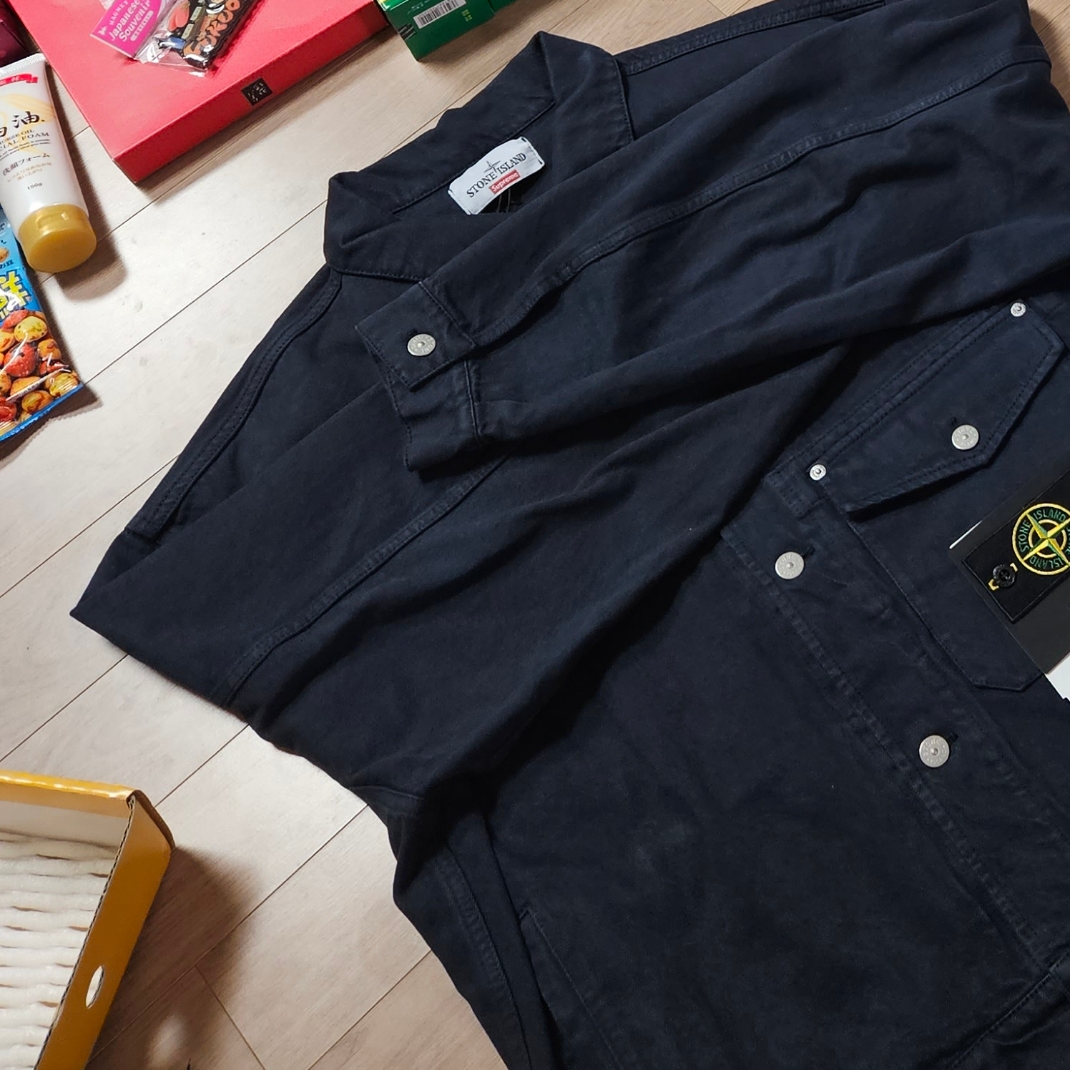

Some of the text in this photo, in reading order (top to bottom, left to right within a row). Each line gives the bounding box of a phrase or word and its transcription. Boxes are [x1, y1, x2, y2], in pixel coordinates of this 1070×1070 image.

[109, 0, 129, 26] MAGNET
[118, 0, 152, 42] Souvenir
[21, 131, 50, 142] FOAM
[466, 152, 527, 198] STONE ISLAND
[491, 172, 519, 192] Supreme
[1033, 509, 1066, 522] ISLAND
[1018, 520, 1031, 552] STONE
[1029, 555, 1064, 569] ISLAND
